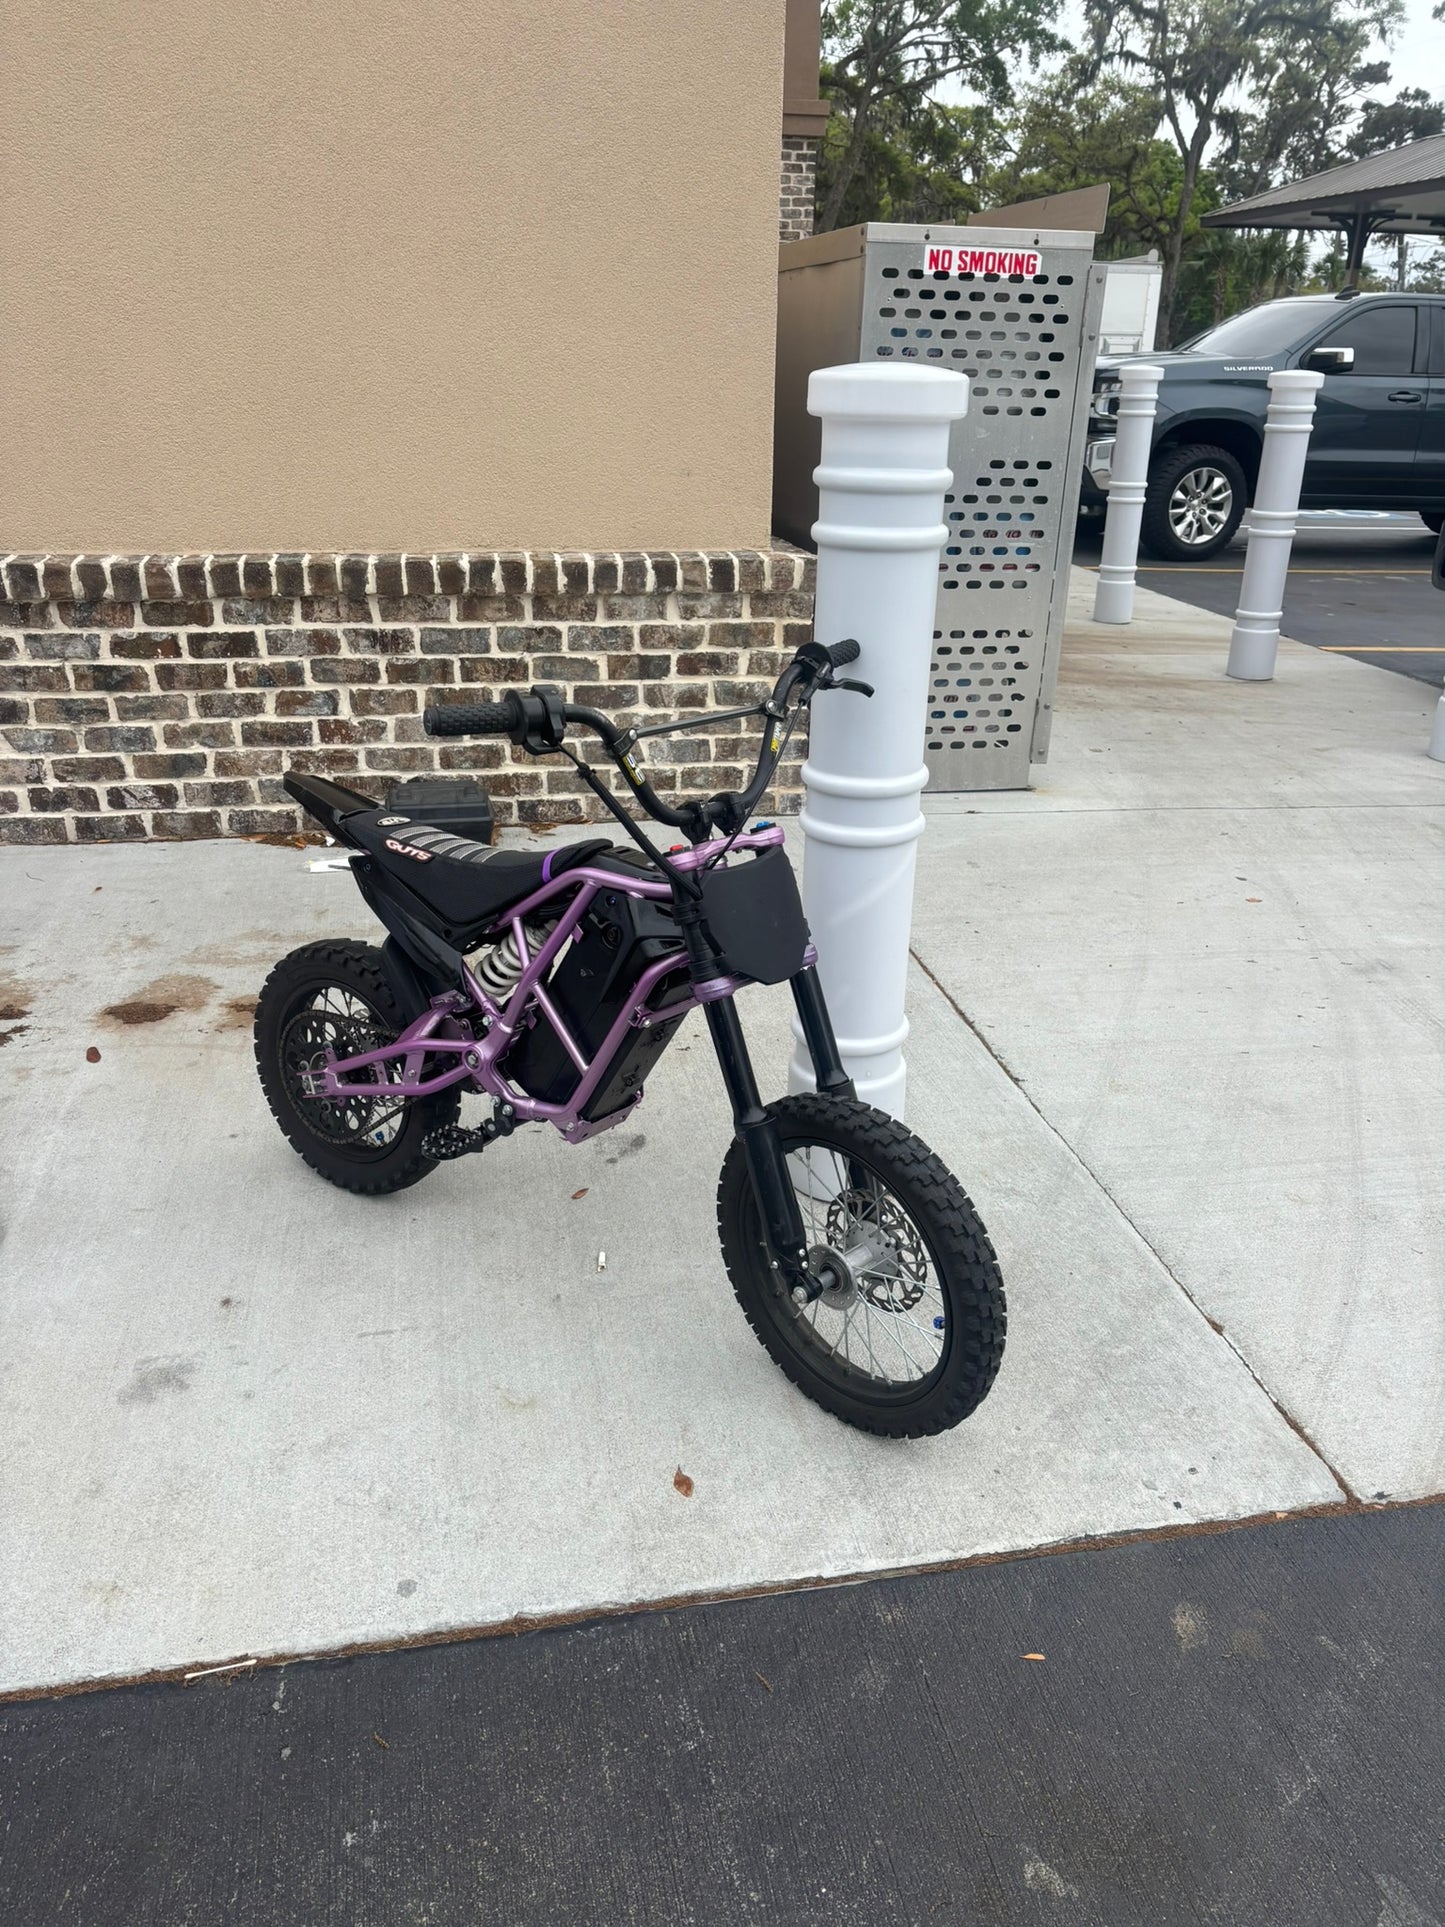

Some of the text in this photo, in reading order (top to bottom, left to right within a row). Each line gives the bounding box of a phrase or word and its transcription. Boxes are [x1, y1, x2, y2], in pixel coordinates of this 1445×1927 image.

[928, 249, 1038, 275] NO SMOKING
[385, 838, 432, 861] GUTS
